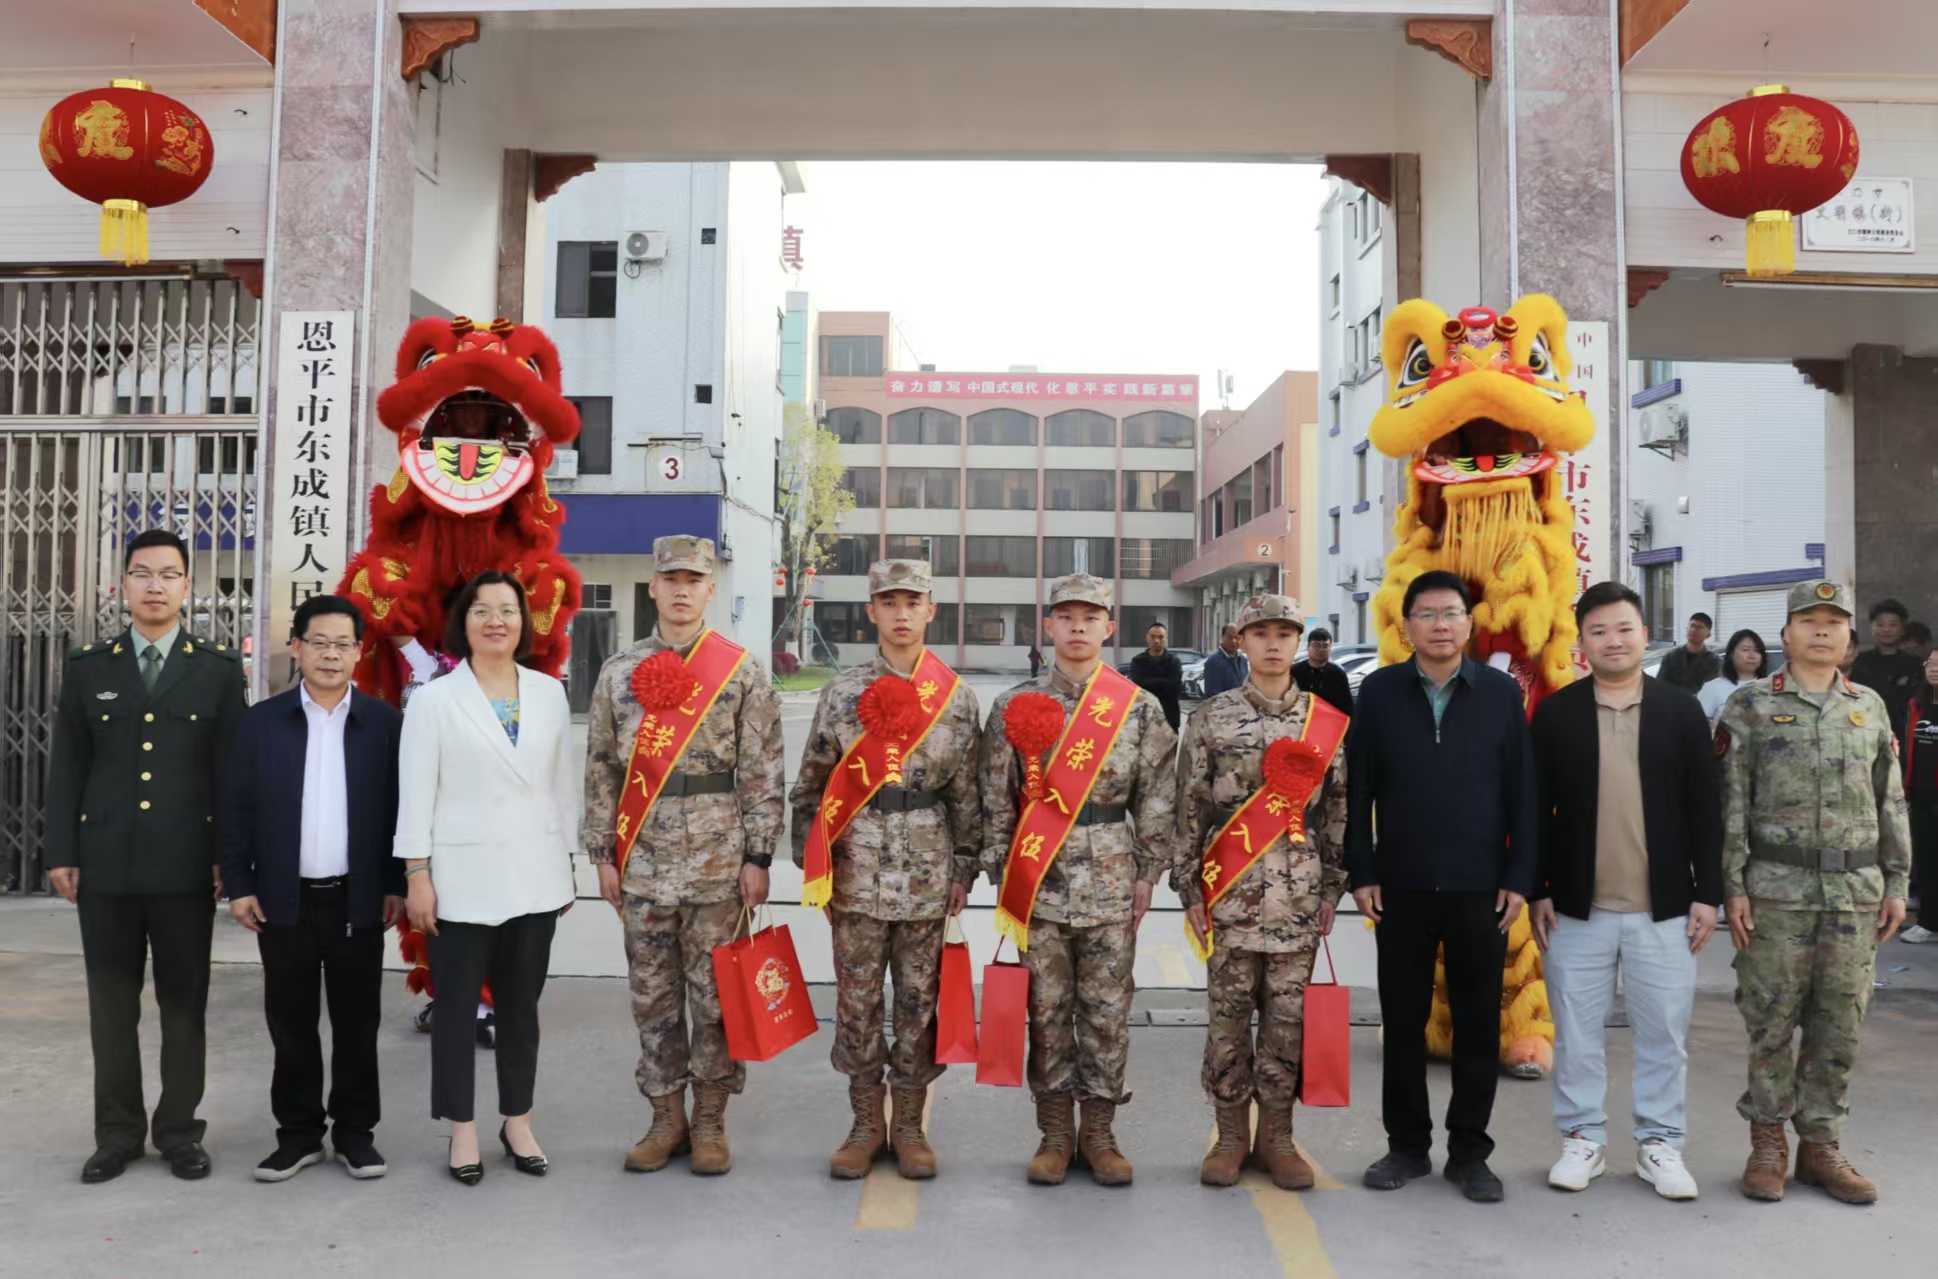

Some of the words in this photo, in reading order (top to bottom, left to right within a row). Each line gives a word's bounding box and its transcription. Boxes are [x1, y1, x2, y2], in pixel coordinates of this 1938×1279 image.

[285, 320, 337, 682] 恩平市东成镇人民
[664, 457, 679, 480] 3
[1260, 544, 1269, 557] 2
[824, 679, 940, 825] 光入伍
[1020, 696, 1114, 862] 光荣入伍
